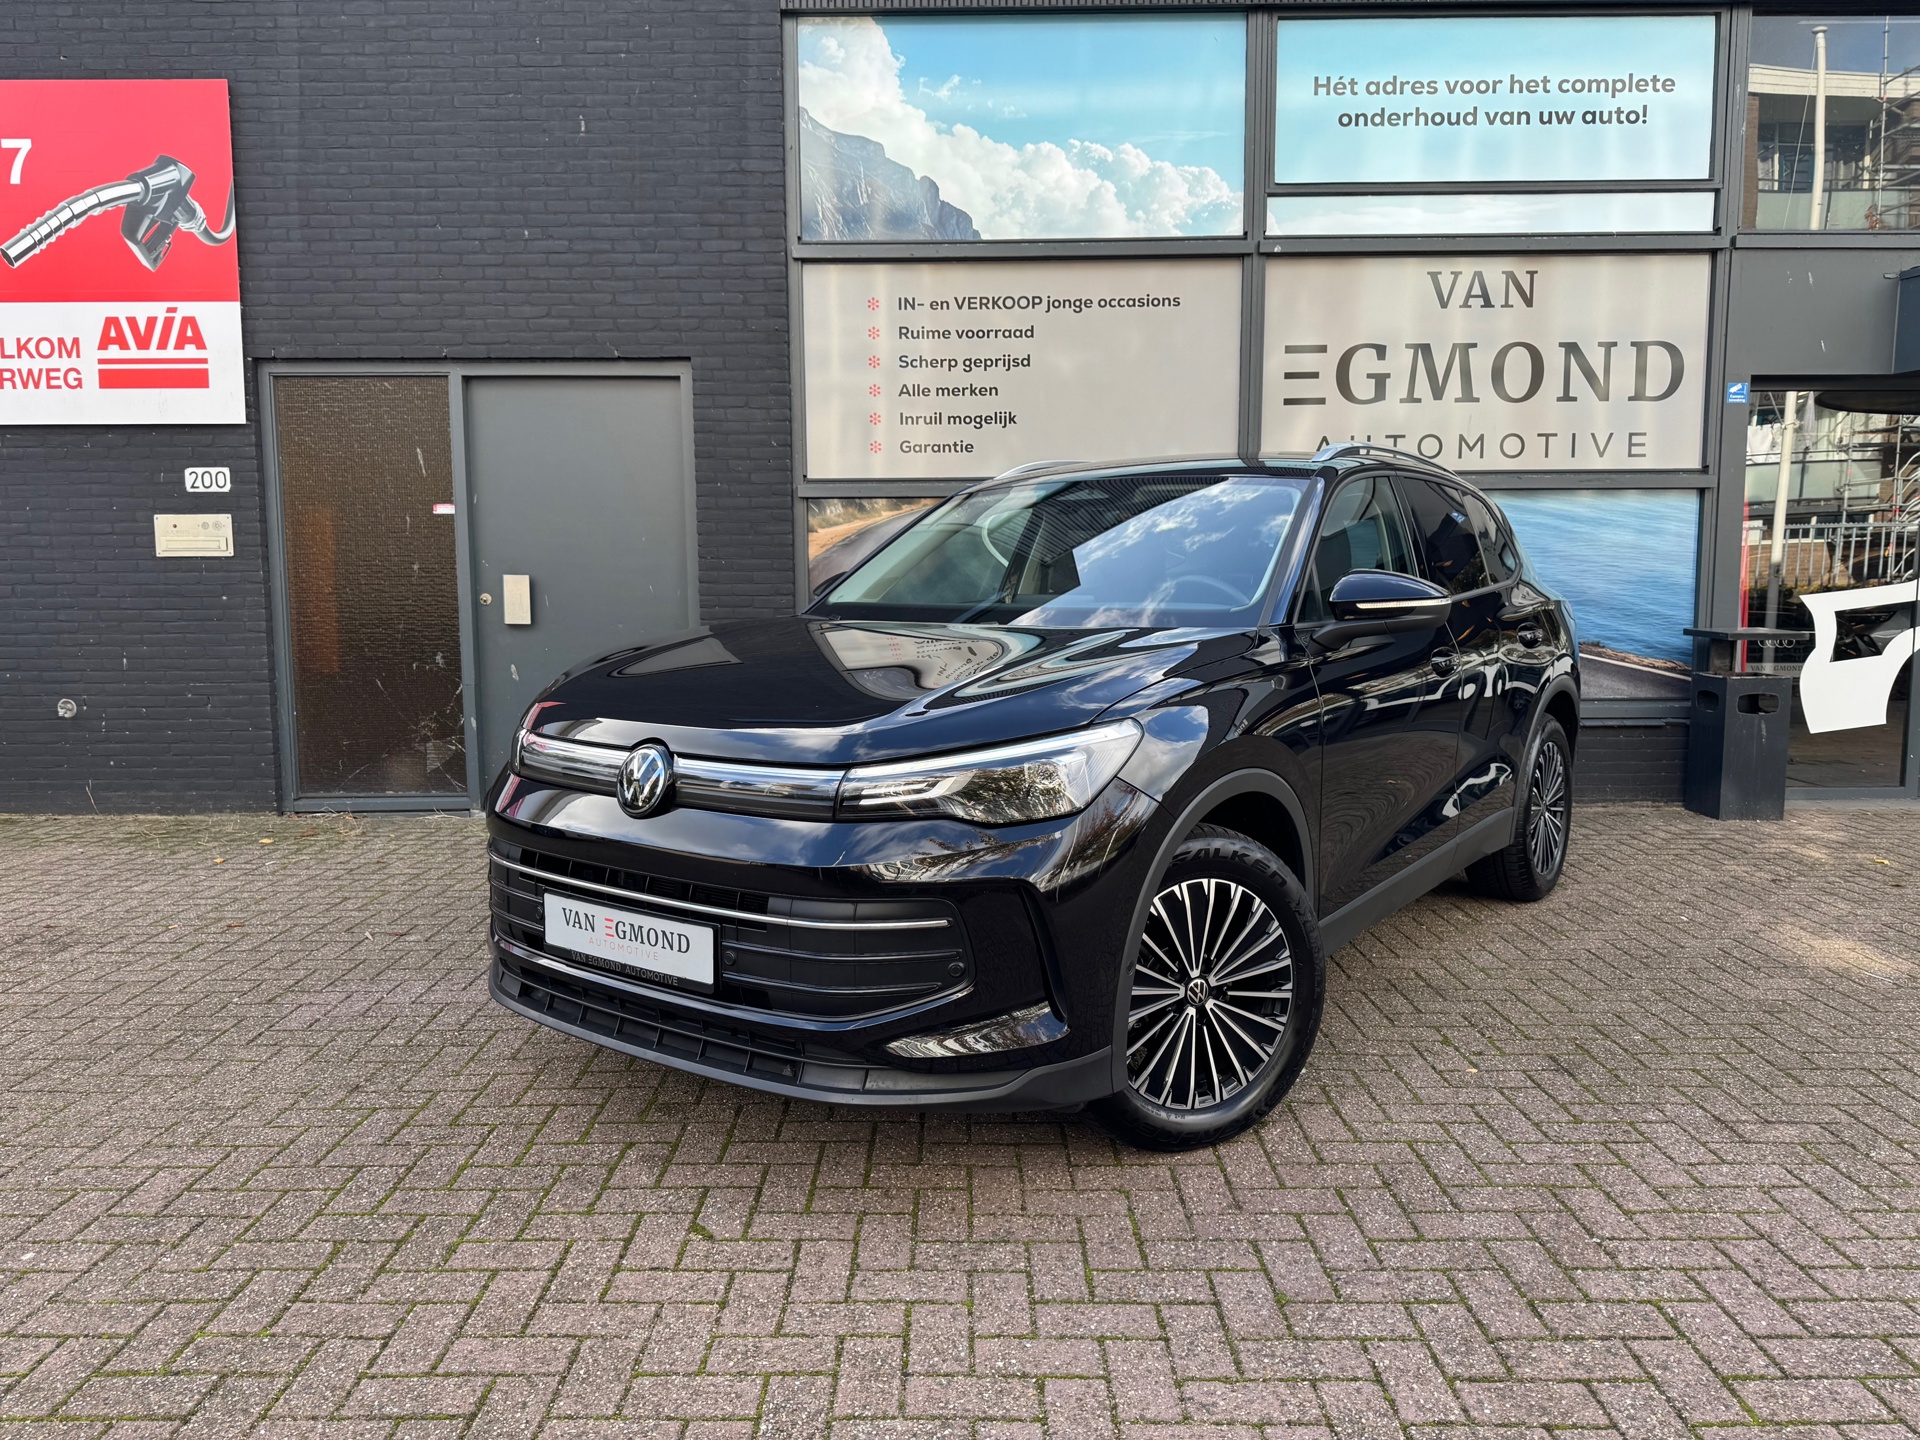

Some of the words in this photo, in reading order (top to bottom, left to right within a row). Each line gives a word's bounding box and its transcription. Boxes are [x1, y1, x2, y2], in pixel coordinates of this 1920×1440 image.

[1313, 76, 1359, 96] Hét
[1365, 75, 1439, 96] adres
[1445, 79, 1503, 95] voor
[1509, 73, 1551, 95] het
[1557, 73, 1676, 98] complete
[1337, 106, 1478, 127] onderhoud
[1484, 110, 1531, 126] van
[1538, 110, 1576, 126] uw
[1581, 104, 1648, 125] auto!
[1, 138, 32, 185] 7
[1427, 270, 1538, 309] VAN
[898, 297, 925, 311] IN-
[930, 299, 950, 311] en
[954, 296, 1043, 311] VERKOOP
[1046, 296, 1094, 314] jonge
[1097, 294, 1181, 309] occasions
[97, 307, 208, 350] AVIA
[898, 325, 952, 340] Ruime
[955, 325, 1035, 340] voorraad
[898, 354, 959, 373] Scherp
[963, 353, 1031, 373] geprijsd
[1283, 341, 1685, 406] EGMOND
[898, 383, 932, 398] Alle
[935, 382, 999, 398] merken
[899, 411, 943, 426] Inruil
[946, 411, 1018, 430] mogelijk
[899, 439, 975, 454] Garantie
[189, 471, 227, 489] 200
[562, 907, 596, 933] VAN
[605, 917, 691, 954] EGMOND
[589, 936, 659, 961] AUTOMOTIVE
[571, 951, 587, 962] VAN
[625, 965, 679, 986] AUTOMOTIVE
